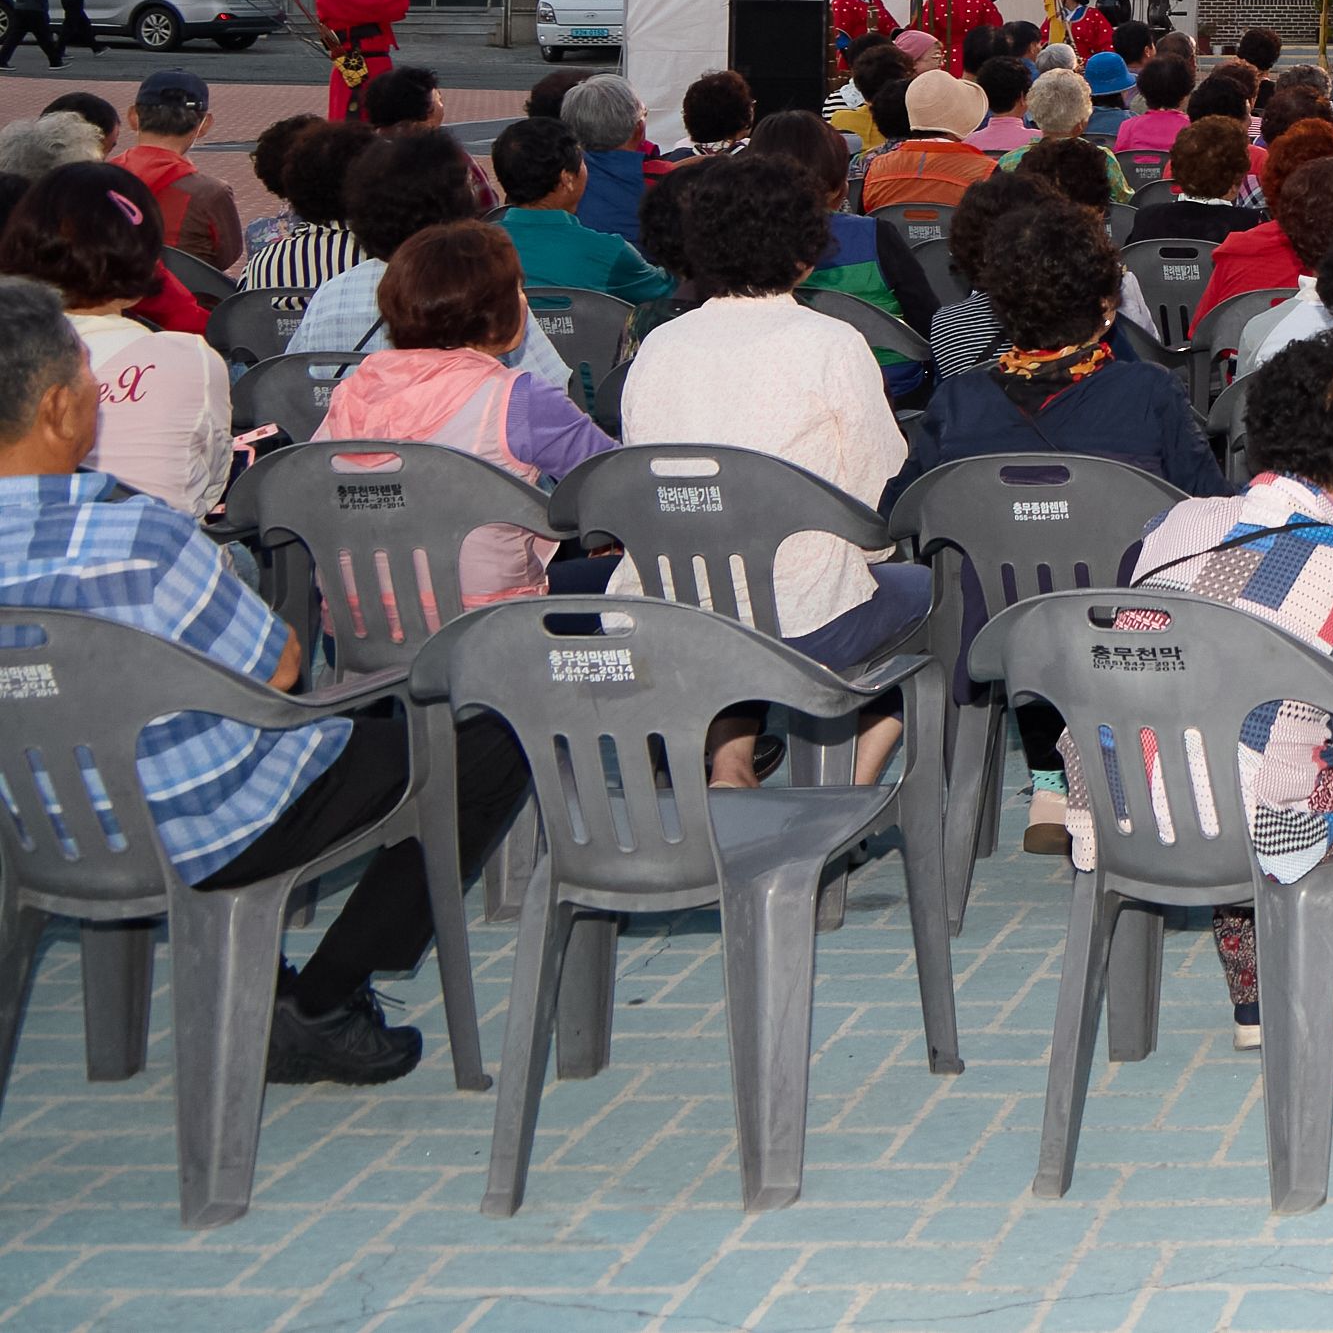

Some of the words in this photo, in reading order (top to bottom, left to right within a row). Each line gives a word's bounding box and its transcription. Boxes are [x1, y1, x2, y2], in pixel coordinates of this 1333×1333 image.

[337, 483, 402, 498] 충무천막렌탈
[660, 503, 723, 513] 055-642-1658
[1012, 500, 1069, 515] 충무종합렌탈
[1014, 513, 1070, 522] 055-644-2014
[549, 648, 632, 666] 충무천막렌탈
[1090, 644, 1183, 662] 충무천막
[551, 664, 634, 675] T.644-2014
